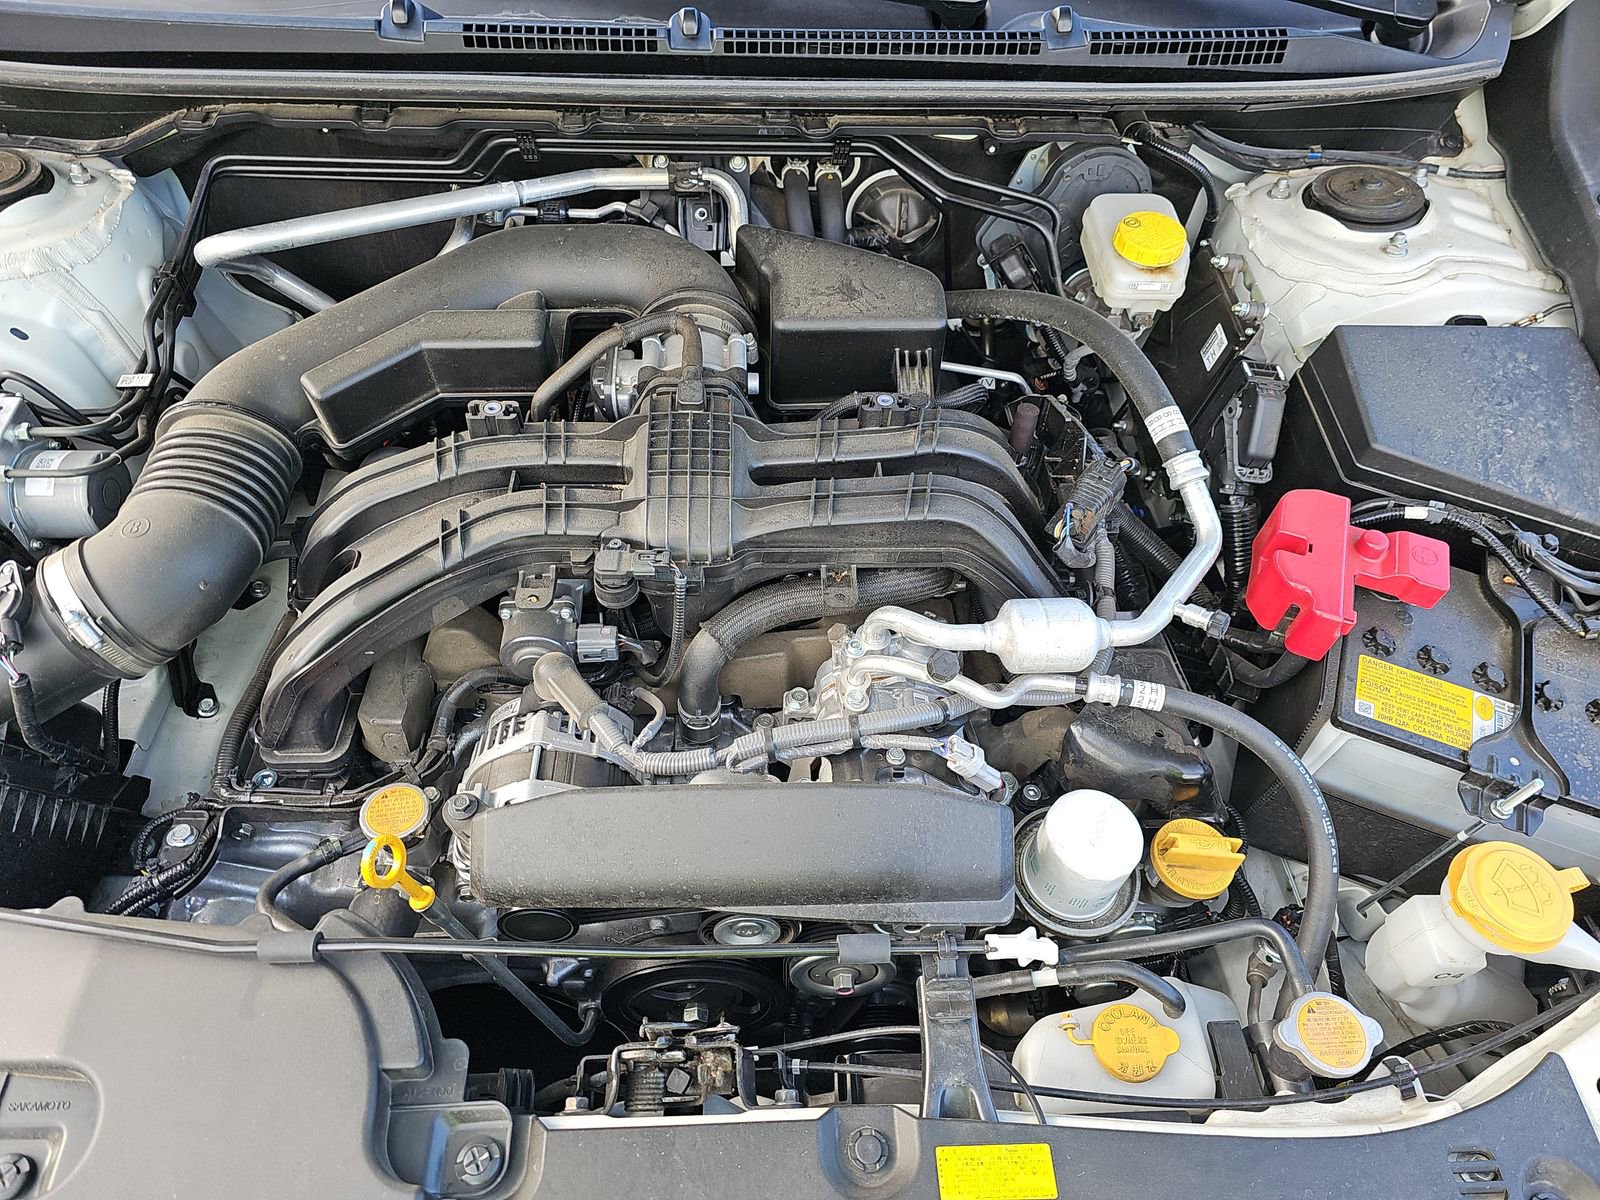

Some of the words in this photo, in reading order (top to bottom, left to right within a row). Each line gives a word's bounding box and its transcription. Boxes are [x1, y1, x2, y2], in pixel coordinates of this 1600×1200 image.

[1361, 657, 1394, 672] DANGER
[1397, 665, 1425, 681] EXPLOSIVE
[1360, 678, 1391, 694] POISON
[1395, 690, 1416, 702] CAUSES
[1098, 1007, 1159, 1032] COOLANT
[8, 1100, 72, 1112] SAKAMOTO
